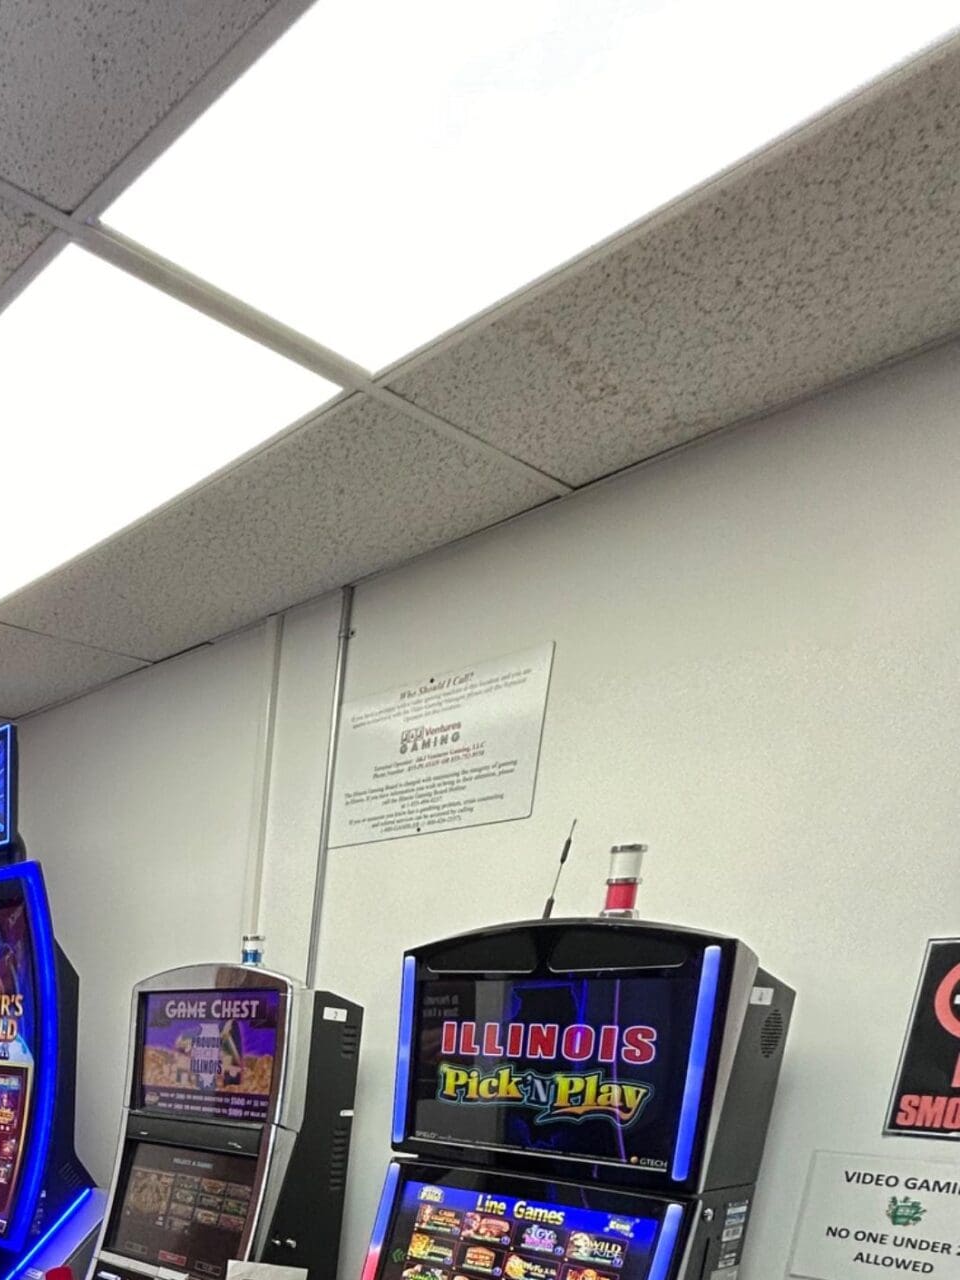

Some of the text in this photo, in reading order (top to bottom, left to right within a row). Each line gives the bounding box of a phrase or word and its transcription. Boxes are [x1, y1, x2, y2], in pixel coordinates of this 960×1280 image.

[424, 721, 461, 737] Ventures
[400, 731, 460, 754] GAMING
[165, 999, 259, 1018] GAME CHEST
[441, 1021, 657, 1064] ILLINOIS
[442, 1064, 523, 1100] Pick
[552, 1073, 647, 1121] Play
[639, 1158, 668, 1168] GTECH
[844, 1170, 960, 1196] VIDEO GAMI
[475, 1194, 566, 1226] Line Games
[589, 1239, 622, 1253] WILD
[826, 1226, 851, 1240] NO
[854, 1230, 889, 1246] ONE
[893, 1235, 953, 1255] UNDER
[852, 1251, 935, 1274] ALLOWED
